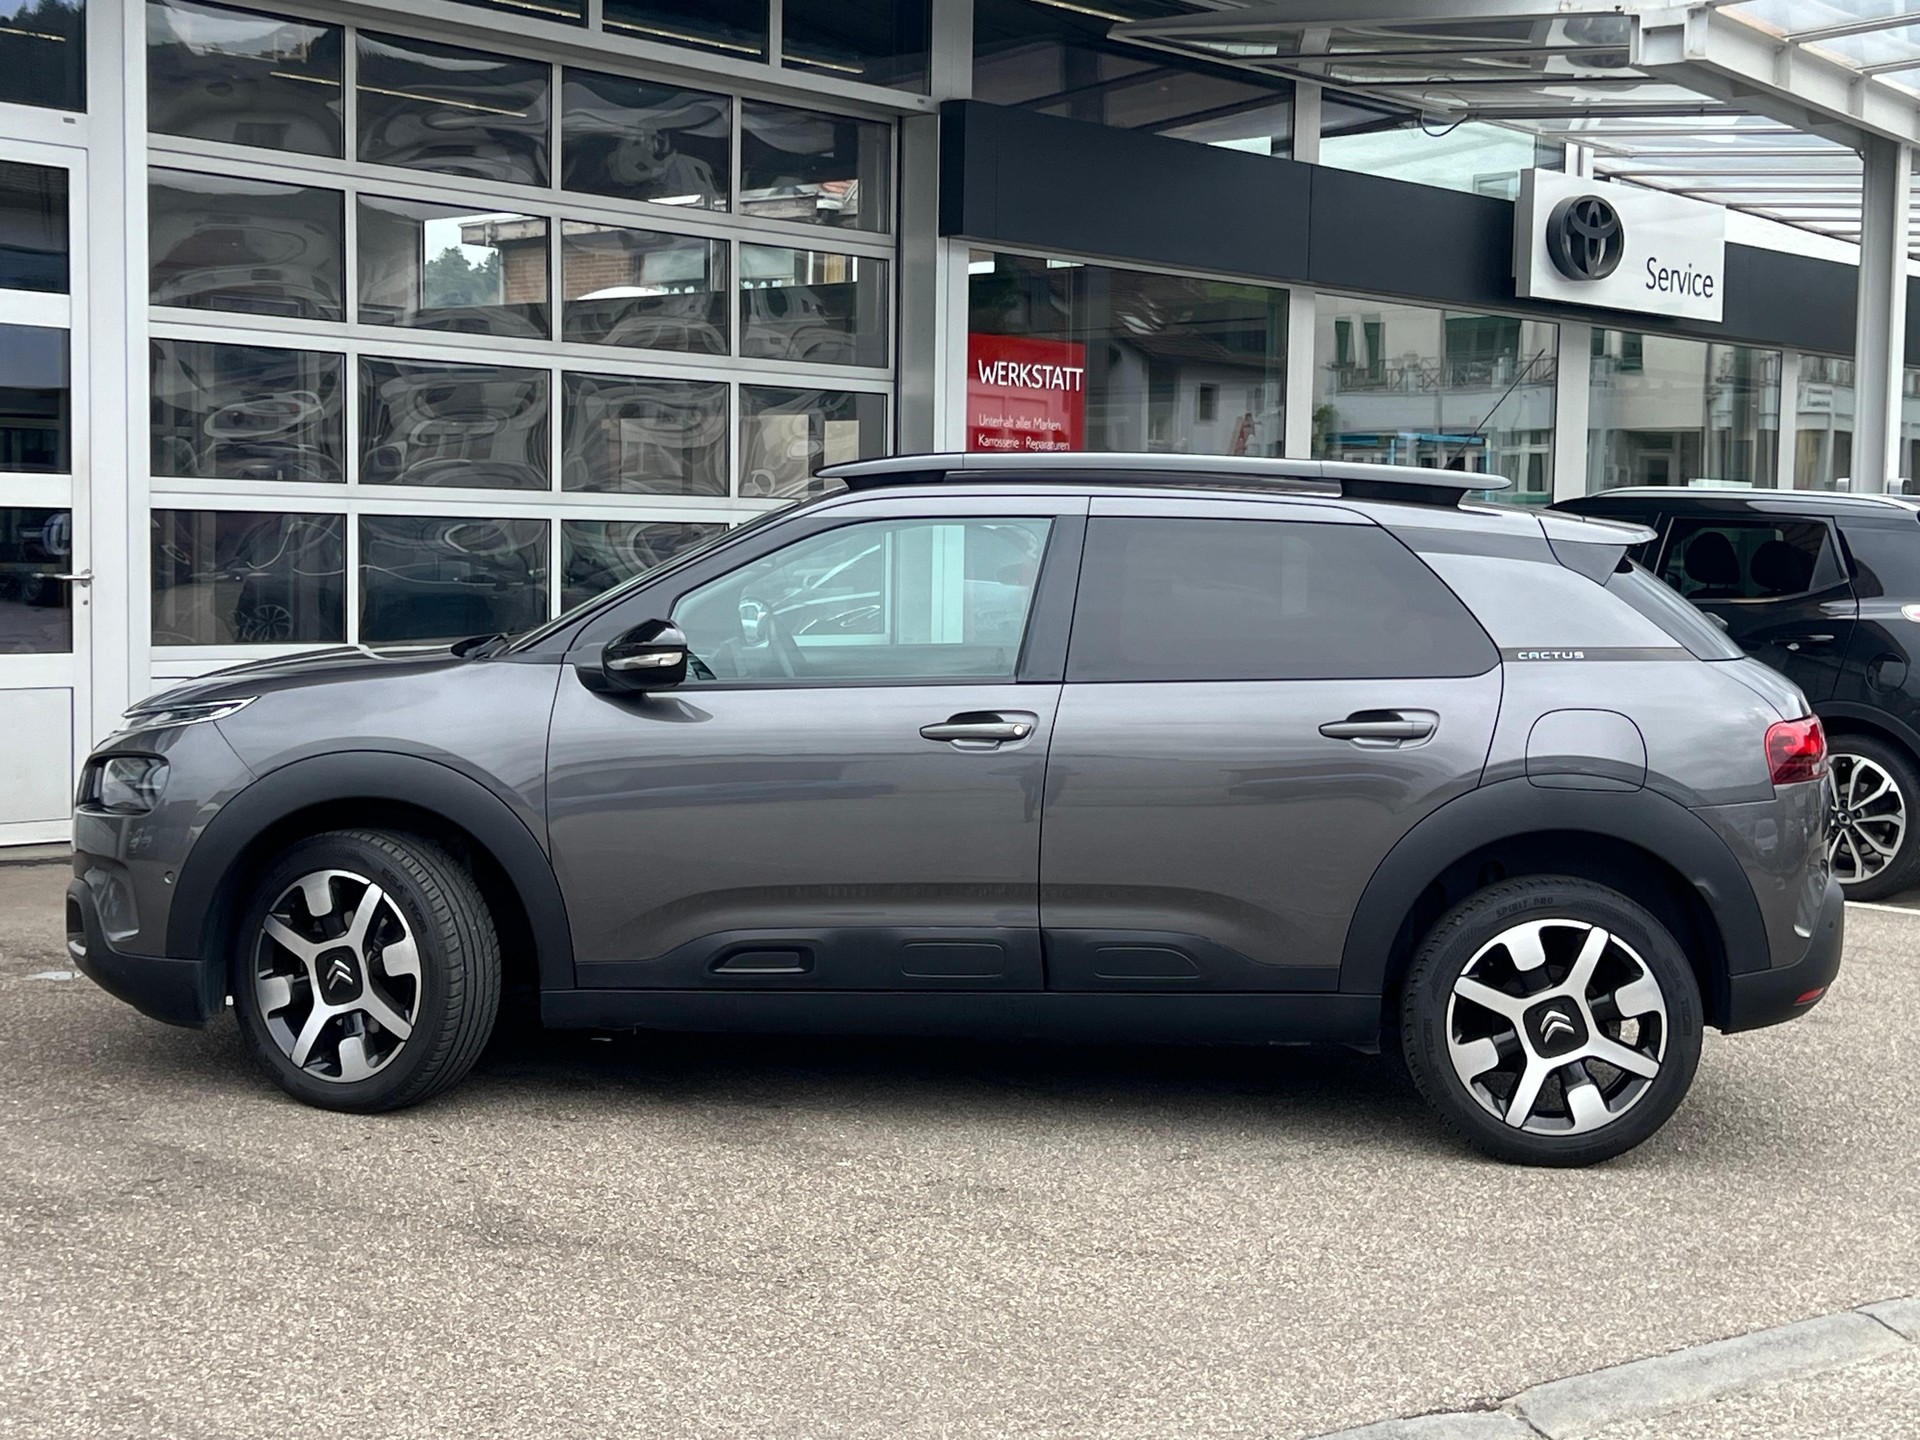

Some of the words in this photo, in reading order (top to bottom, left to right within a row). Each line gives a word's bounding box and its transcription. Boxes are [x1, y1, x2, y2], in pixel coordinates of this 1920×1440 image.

[1646, 257, 1713, 298] Service
[978, 360, 1083, 391] WERKSTATT
[979, 414, 1013, 428] Unterhalt
[1015, 416, 1031, 429] aller
[1033, 418, 1061, 431] Marken
[1025, 436, 1070, 451] Reparaturen
[1517, 651, 1584, 660] CACTUS
[1496, 901, 1528, 918] SPIRIT
[1533, 897, 1553, 905] PRO
